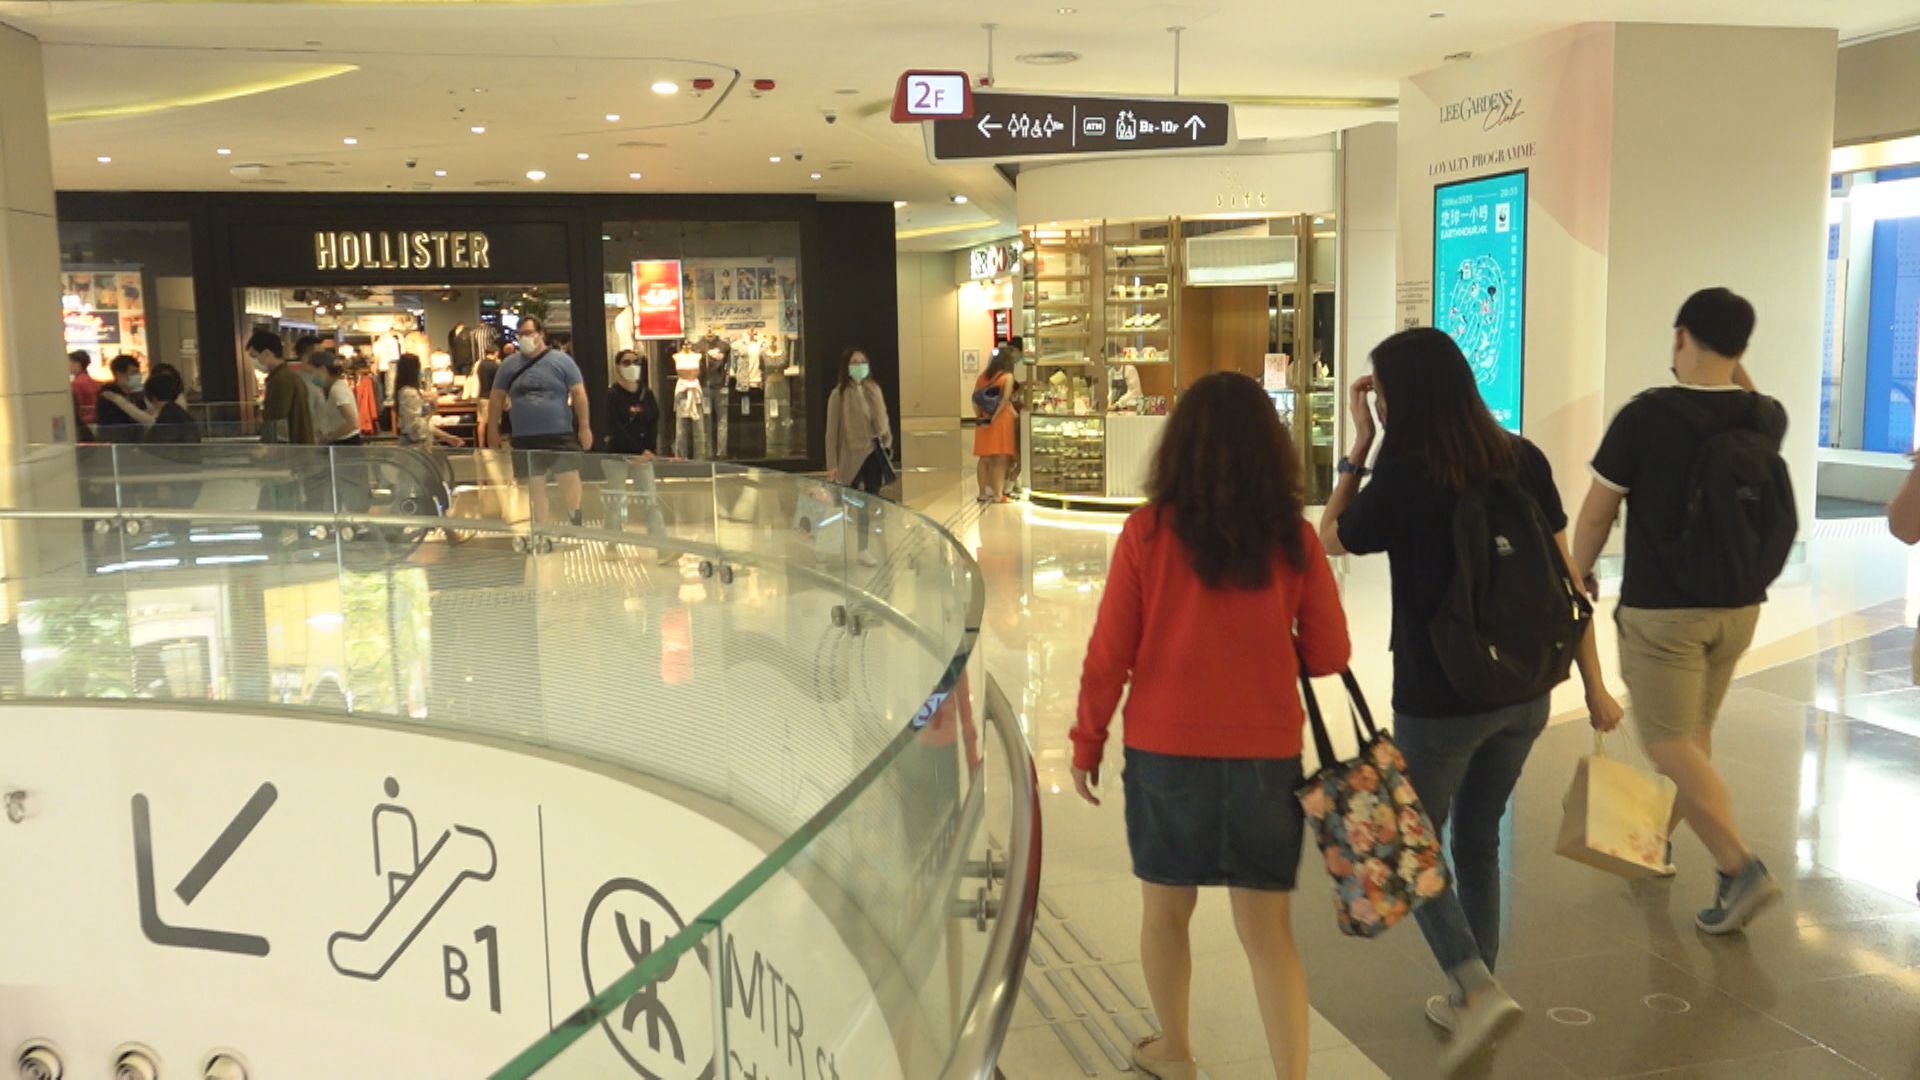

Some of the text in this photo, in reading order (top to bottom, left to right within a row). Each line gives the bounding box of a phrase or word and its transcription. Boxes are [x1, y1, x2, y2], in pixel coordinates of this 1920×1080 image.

[914, 81, 945, 108] 2F
[1086, 122, 1103, 131] ATM
[1429, 142, 1537, 176] LOYALTY PROGRAMME
[314, 231, 491, 270] HOLLISTER
[443, 924, 502, 1014] B1
[725, 932, 806, 1080] MTR
